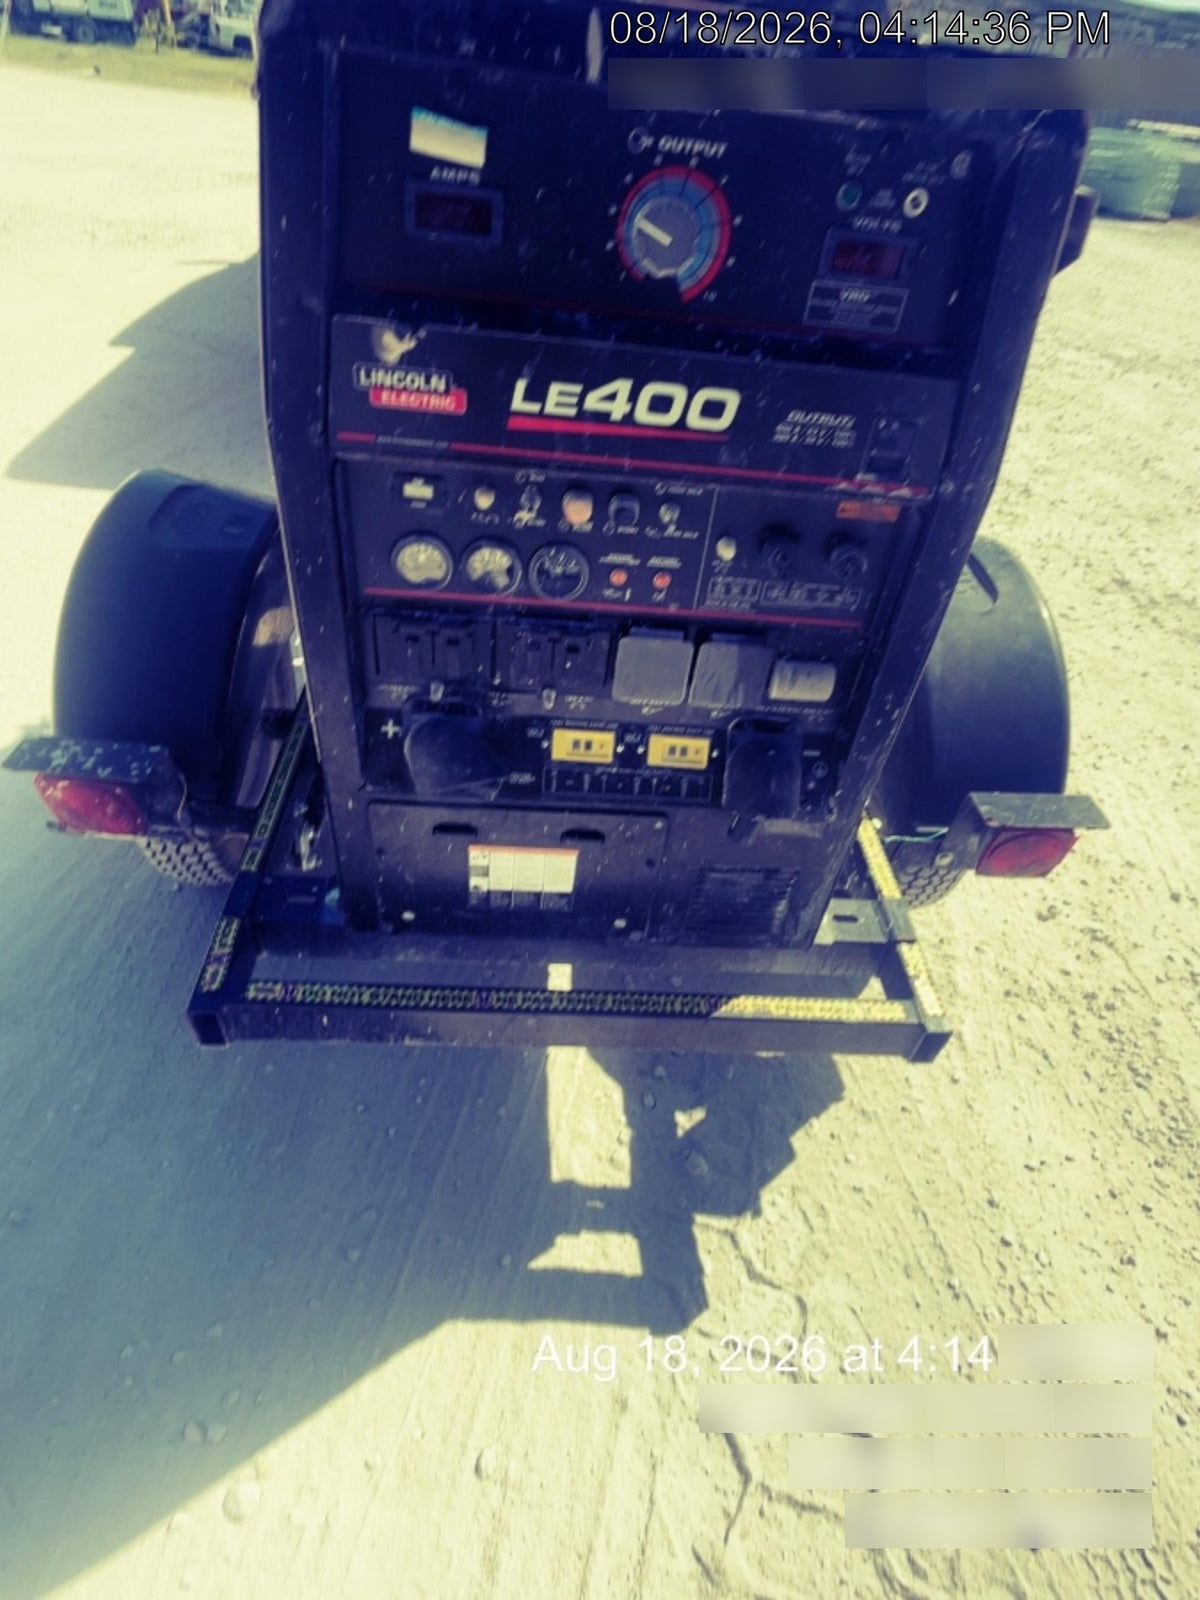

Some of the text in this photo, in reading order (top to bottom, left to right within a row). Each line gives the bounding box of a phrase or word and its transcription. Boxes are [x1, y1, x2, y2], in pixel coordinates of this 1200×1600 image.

[657, 135, 729, 159] OUTPUT
[430, 165, 481, 186] AMPS
[359, 366, 447, 394] LINCOLN
[380, 387, 457, 412] ELECTRIC
[508, 376, 741, 433] LE400
